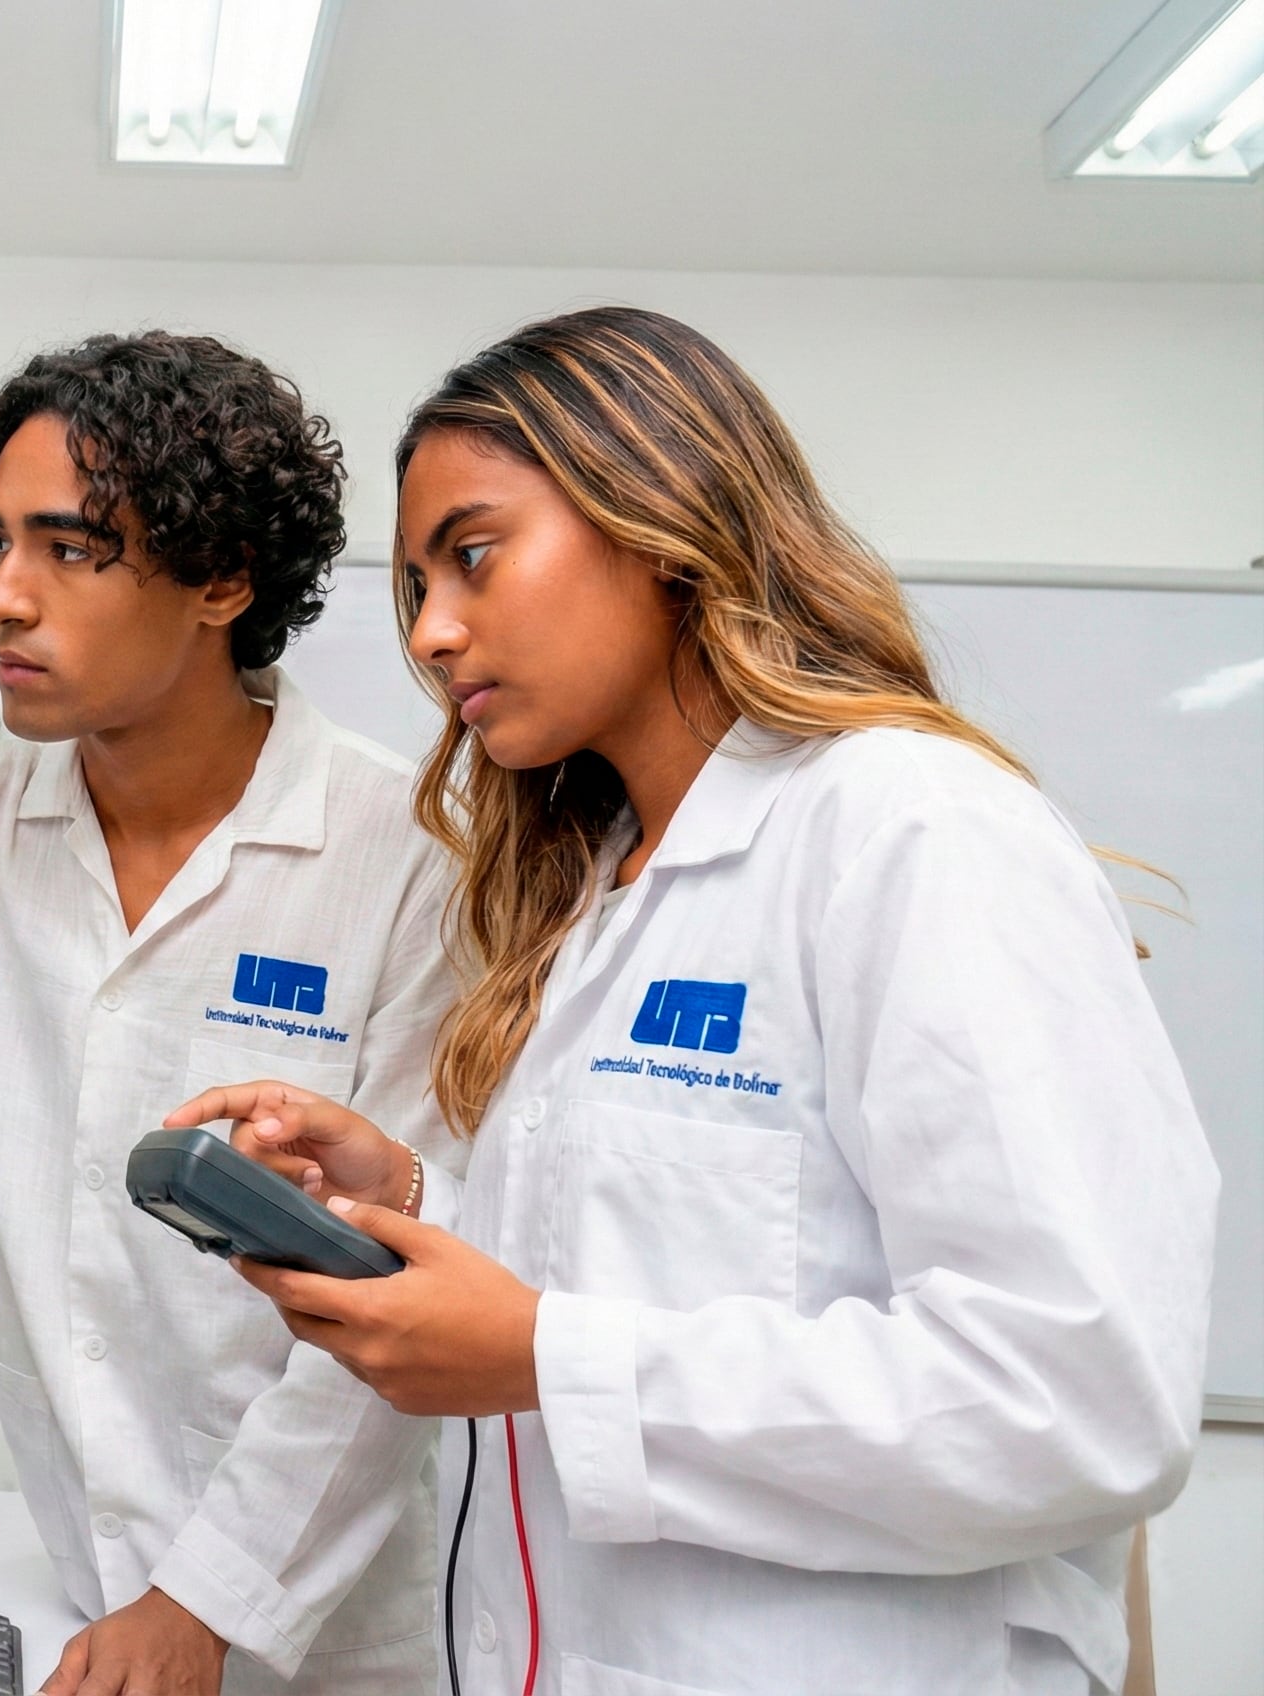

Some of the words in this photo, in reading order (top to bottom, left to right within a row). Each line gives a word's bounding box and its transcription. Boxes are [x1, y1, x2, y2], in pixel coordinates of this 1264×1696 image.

[233, 953, 328, 1015] UTB
[631, 979, 747, 1054] UTB
[715, 1068, 730, 1087] de
